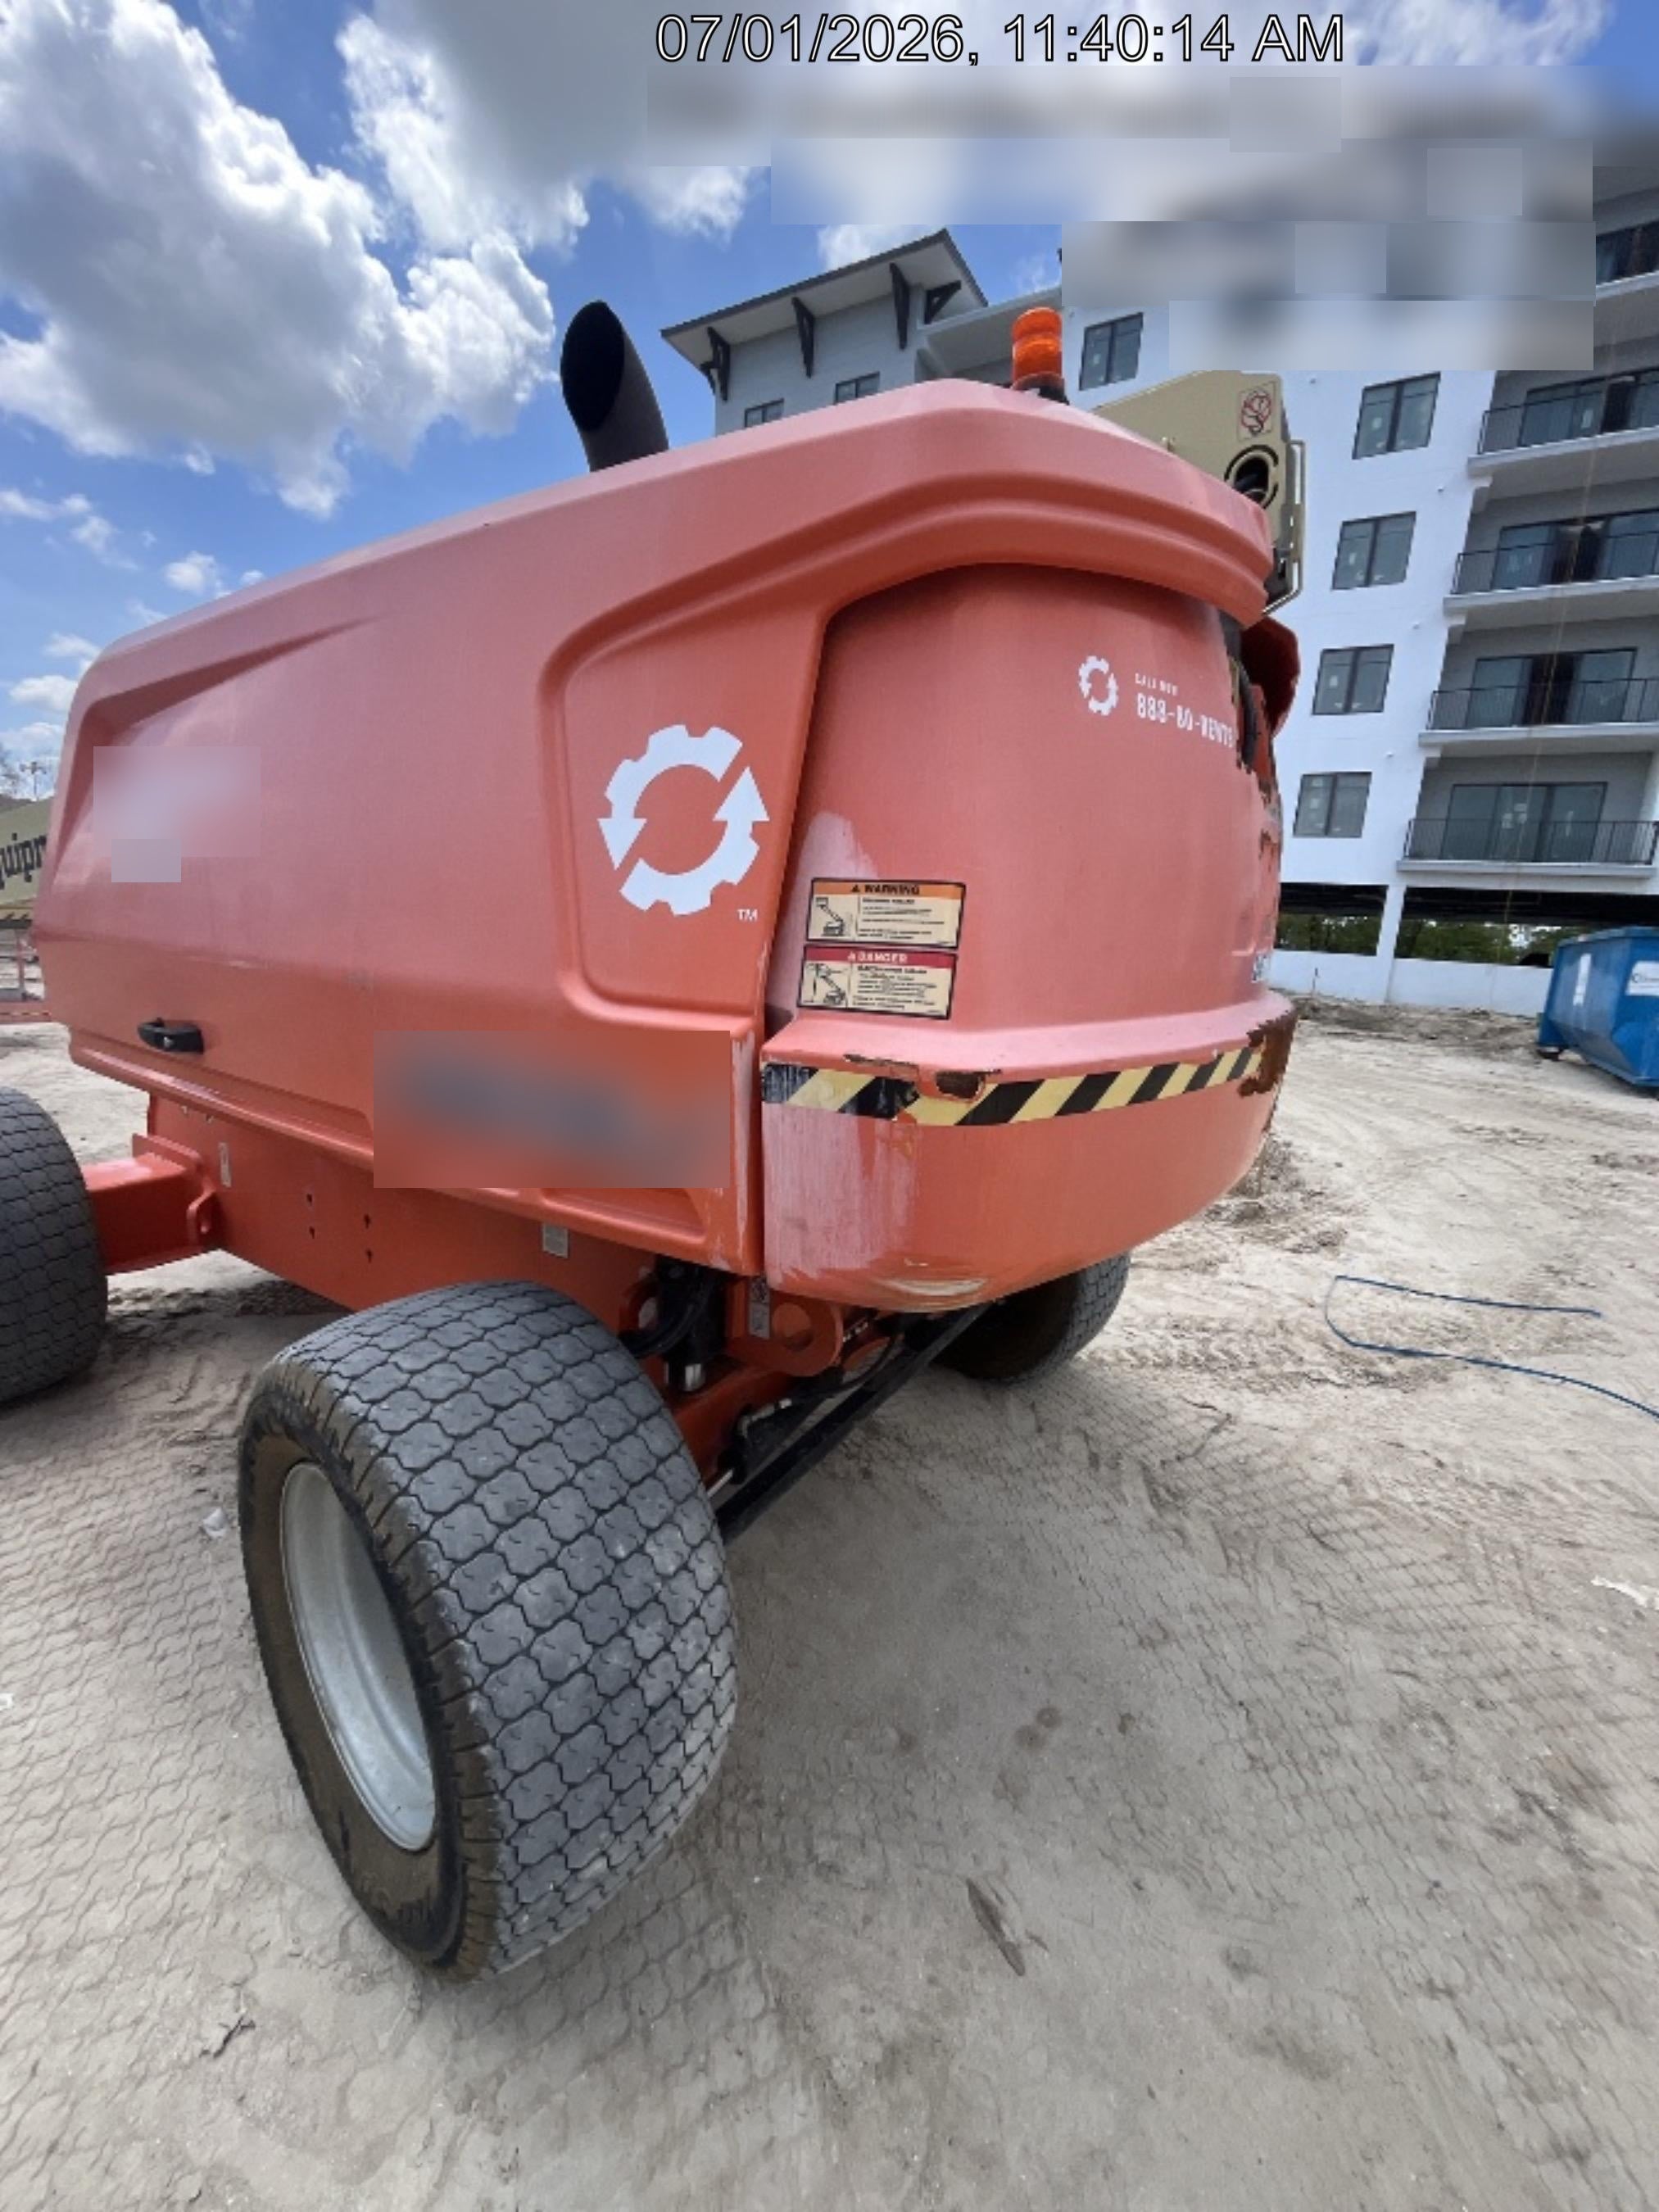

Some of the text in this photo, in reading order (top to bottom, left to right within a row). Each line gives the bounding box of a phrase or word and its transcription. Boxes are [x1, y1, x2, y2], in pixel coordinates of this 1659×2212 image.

[864, 885, 919, 895] WARNING
[737, 909, 758, 920] TM
[858, 952, 908, 963] DANGER
